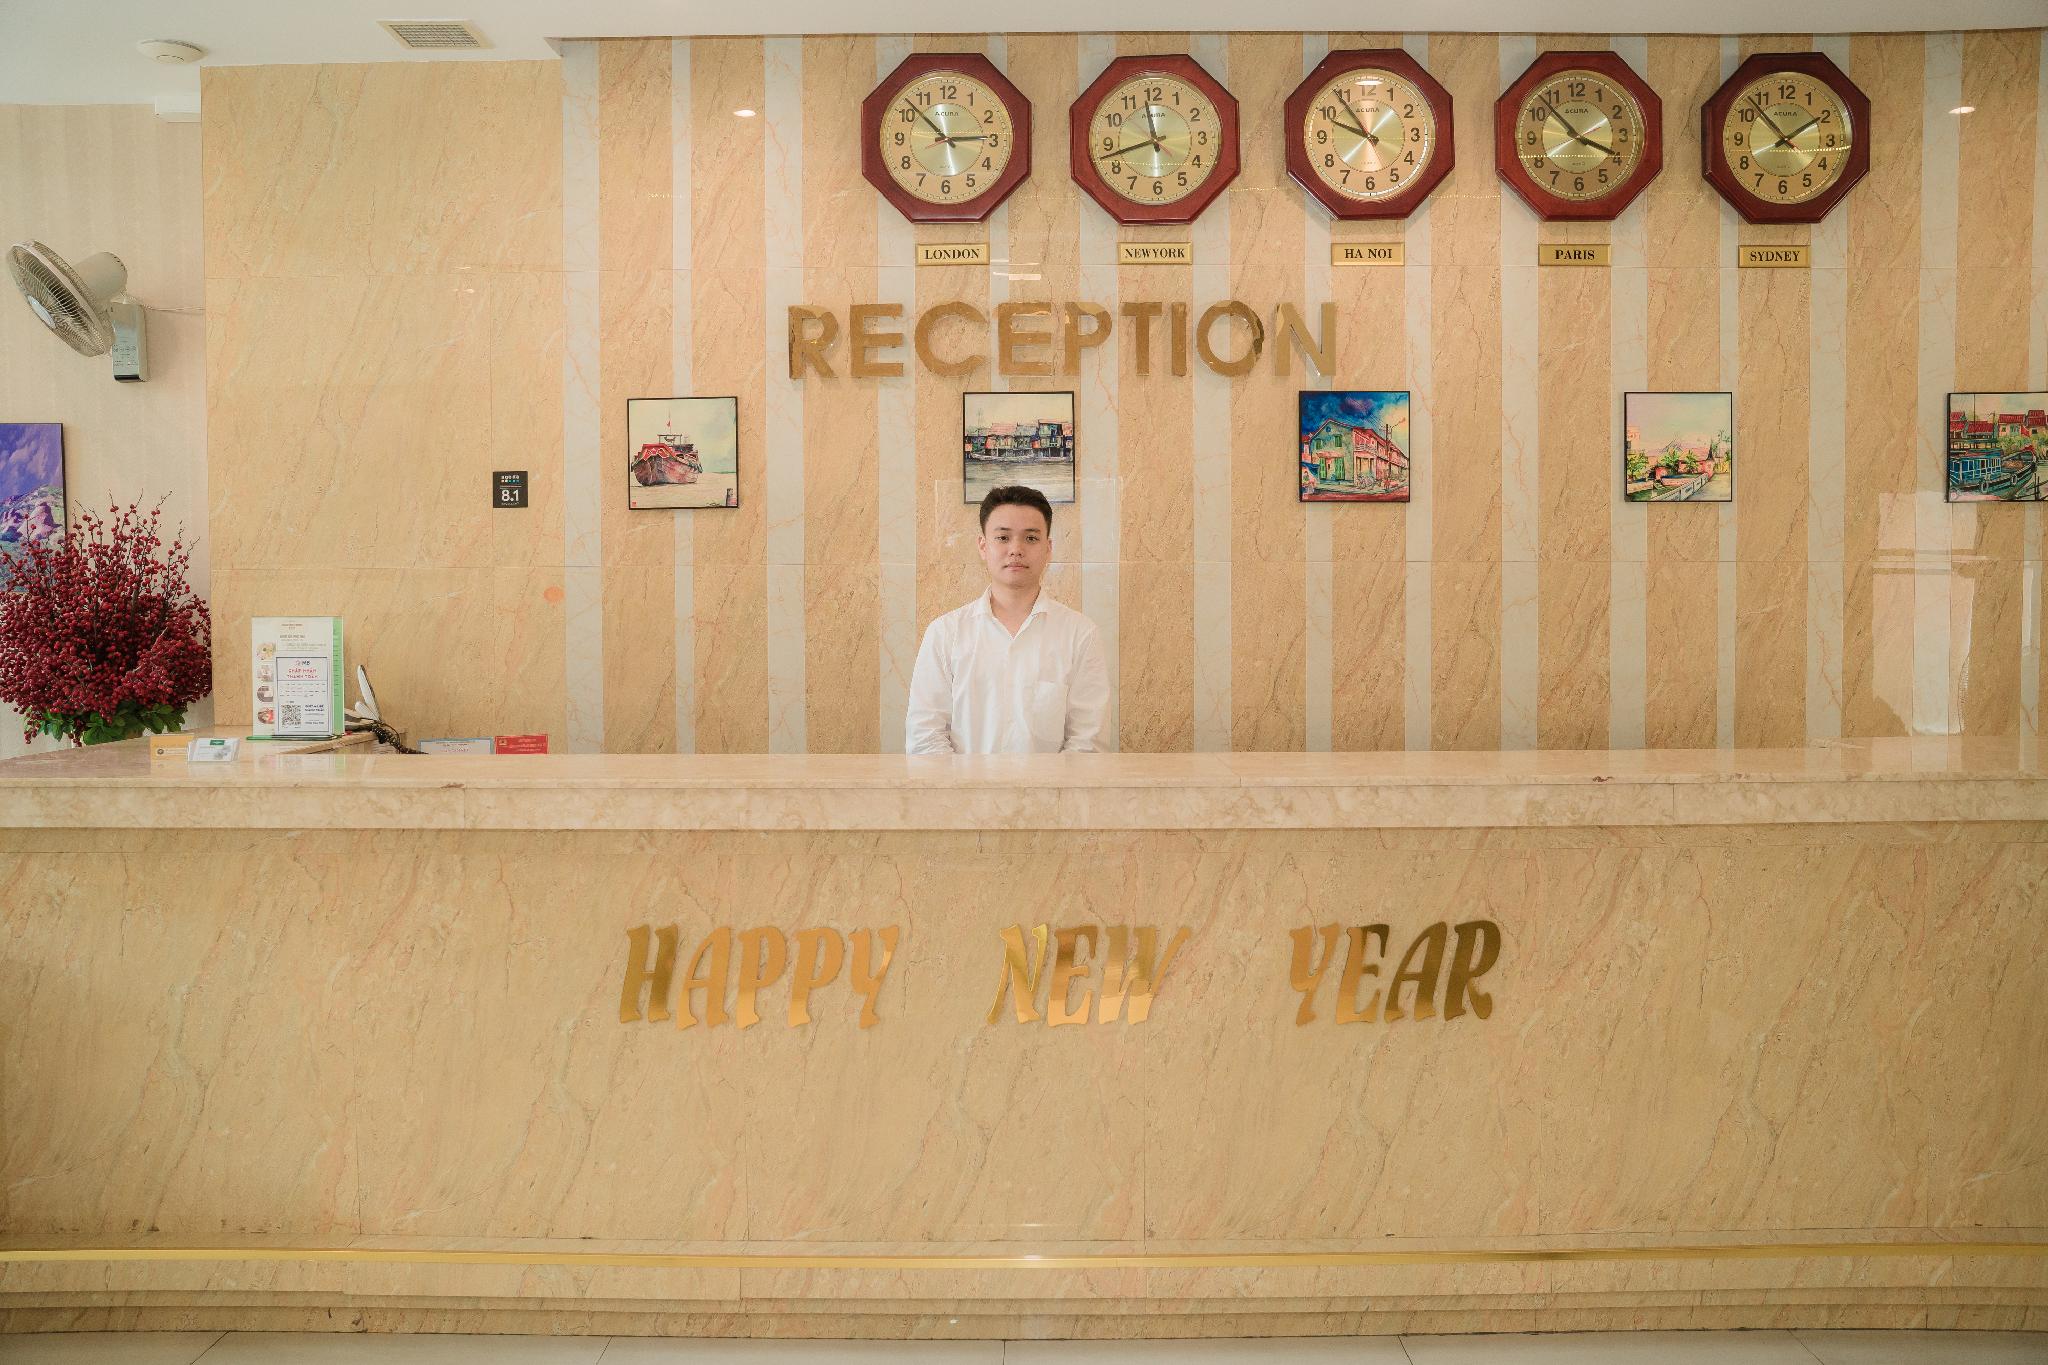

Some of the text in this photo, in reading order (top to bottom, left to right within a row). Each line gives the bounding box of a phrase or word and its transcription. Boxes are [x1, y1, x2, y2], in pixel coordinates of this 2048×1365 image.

[939, 85, 957, 99] 12
[1144, 87, 1162, 102] 12
[1336, 88, 1351, 103] 11
[1359, 85, 1376, 97] 12
[1386, 88, 1394, 102] 1
[1545, 89, 1560, 104] 11
[1567, 83, 1586, 97] 12
[1595, 89, 1602, 102] 1
[1778, 85, 1795, 99] 12
[916, 92, 931, 106] 11
[968, 92, 974, 106] 1
[1121, 95, 1136, 110] 11
[1172, 91, 1179, 105] 1
[1755, 91, 1769, 106] 11
[1805, 92, 1812, 105] 1
[899, 108, 915, 123] 10
[984, 110, 994, 124] 2
[1189, 107, 1200, 122] 2
[1319, 106, 1336, 120] 10
[1404, 104, 1414, 118] 2
[1529, 107, 1546, 121] 10
[1612, 105, 1622, 119] 2
[1738, 108, 1754, 122] 10
[1821, 109, 1830, 124] 2
[1105, 113, 1122, 127] 10
[894, 132, 905, 146] 9
[989, 134, 998, 147] 3
[1197, 131, 1207, 145] 3
[1317, 130, 1327, 144] 9
[1411, 127, 1420, 142] 3
[1527, 131, 1537, 145] 9
[1619, 128, 1628, 143] 3
[1734, 132, 1744, 146] 9
[1826, 134, 1835, 147] 3
[1103, 137, 1114, 152] 9
[901, 156, 911, 170] 8
[982, 157, 992, 170] 4
[1191, 154, 1201, 168] 4
[1324, 154, 1334, 168] 8
[1404, 151, 1414, 165] 4
[1534, 156, 1544, 169] 8
[1612, 151, 1623, 166] 4
[1739, 156, 1749, 170] 8
[1818, 157, 1828, 170] 4
[1112, 160, 1122, 174] 8
[916, 173, 926, 187] 7
[966, 174, 976, 188] 5
[1177, 172, 1187, 186] 5
[1340, 169, 1351, 184] 7
[1390, 168, 1399, 182] 5
[1549, 171, 1560, 185] 7
[1598, 169, 1608, 183] 5
[1755, 174, 1764, 187] 7
[1802, 174, 1812, 188] 5
[941, 180, 950, 194] 6
[1127, 176, 1138, 190] 7
[1153, 181, 1163, 195] 6
[1366, 176, 1375, 190] 6
[1574, 176, 1584, 191] 6
[1778, 180, 1787, 194] 6
[925, 249, 980, 259] LONDON
[1344, 249, 1392, 258] HA NOI
[1555, 250, 1595, 260] PARIS
[1750, 251, 1800, 262] SYDNEY
[788, 299, 1336, 379] RECEPTION
[501, 489, 519, 502] 8.1
[619, 921, 1506, 1031] HAPPY NEW YEAR
